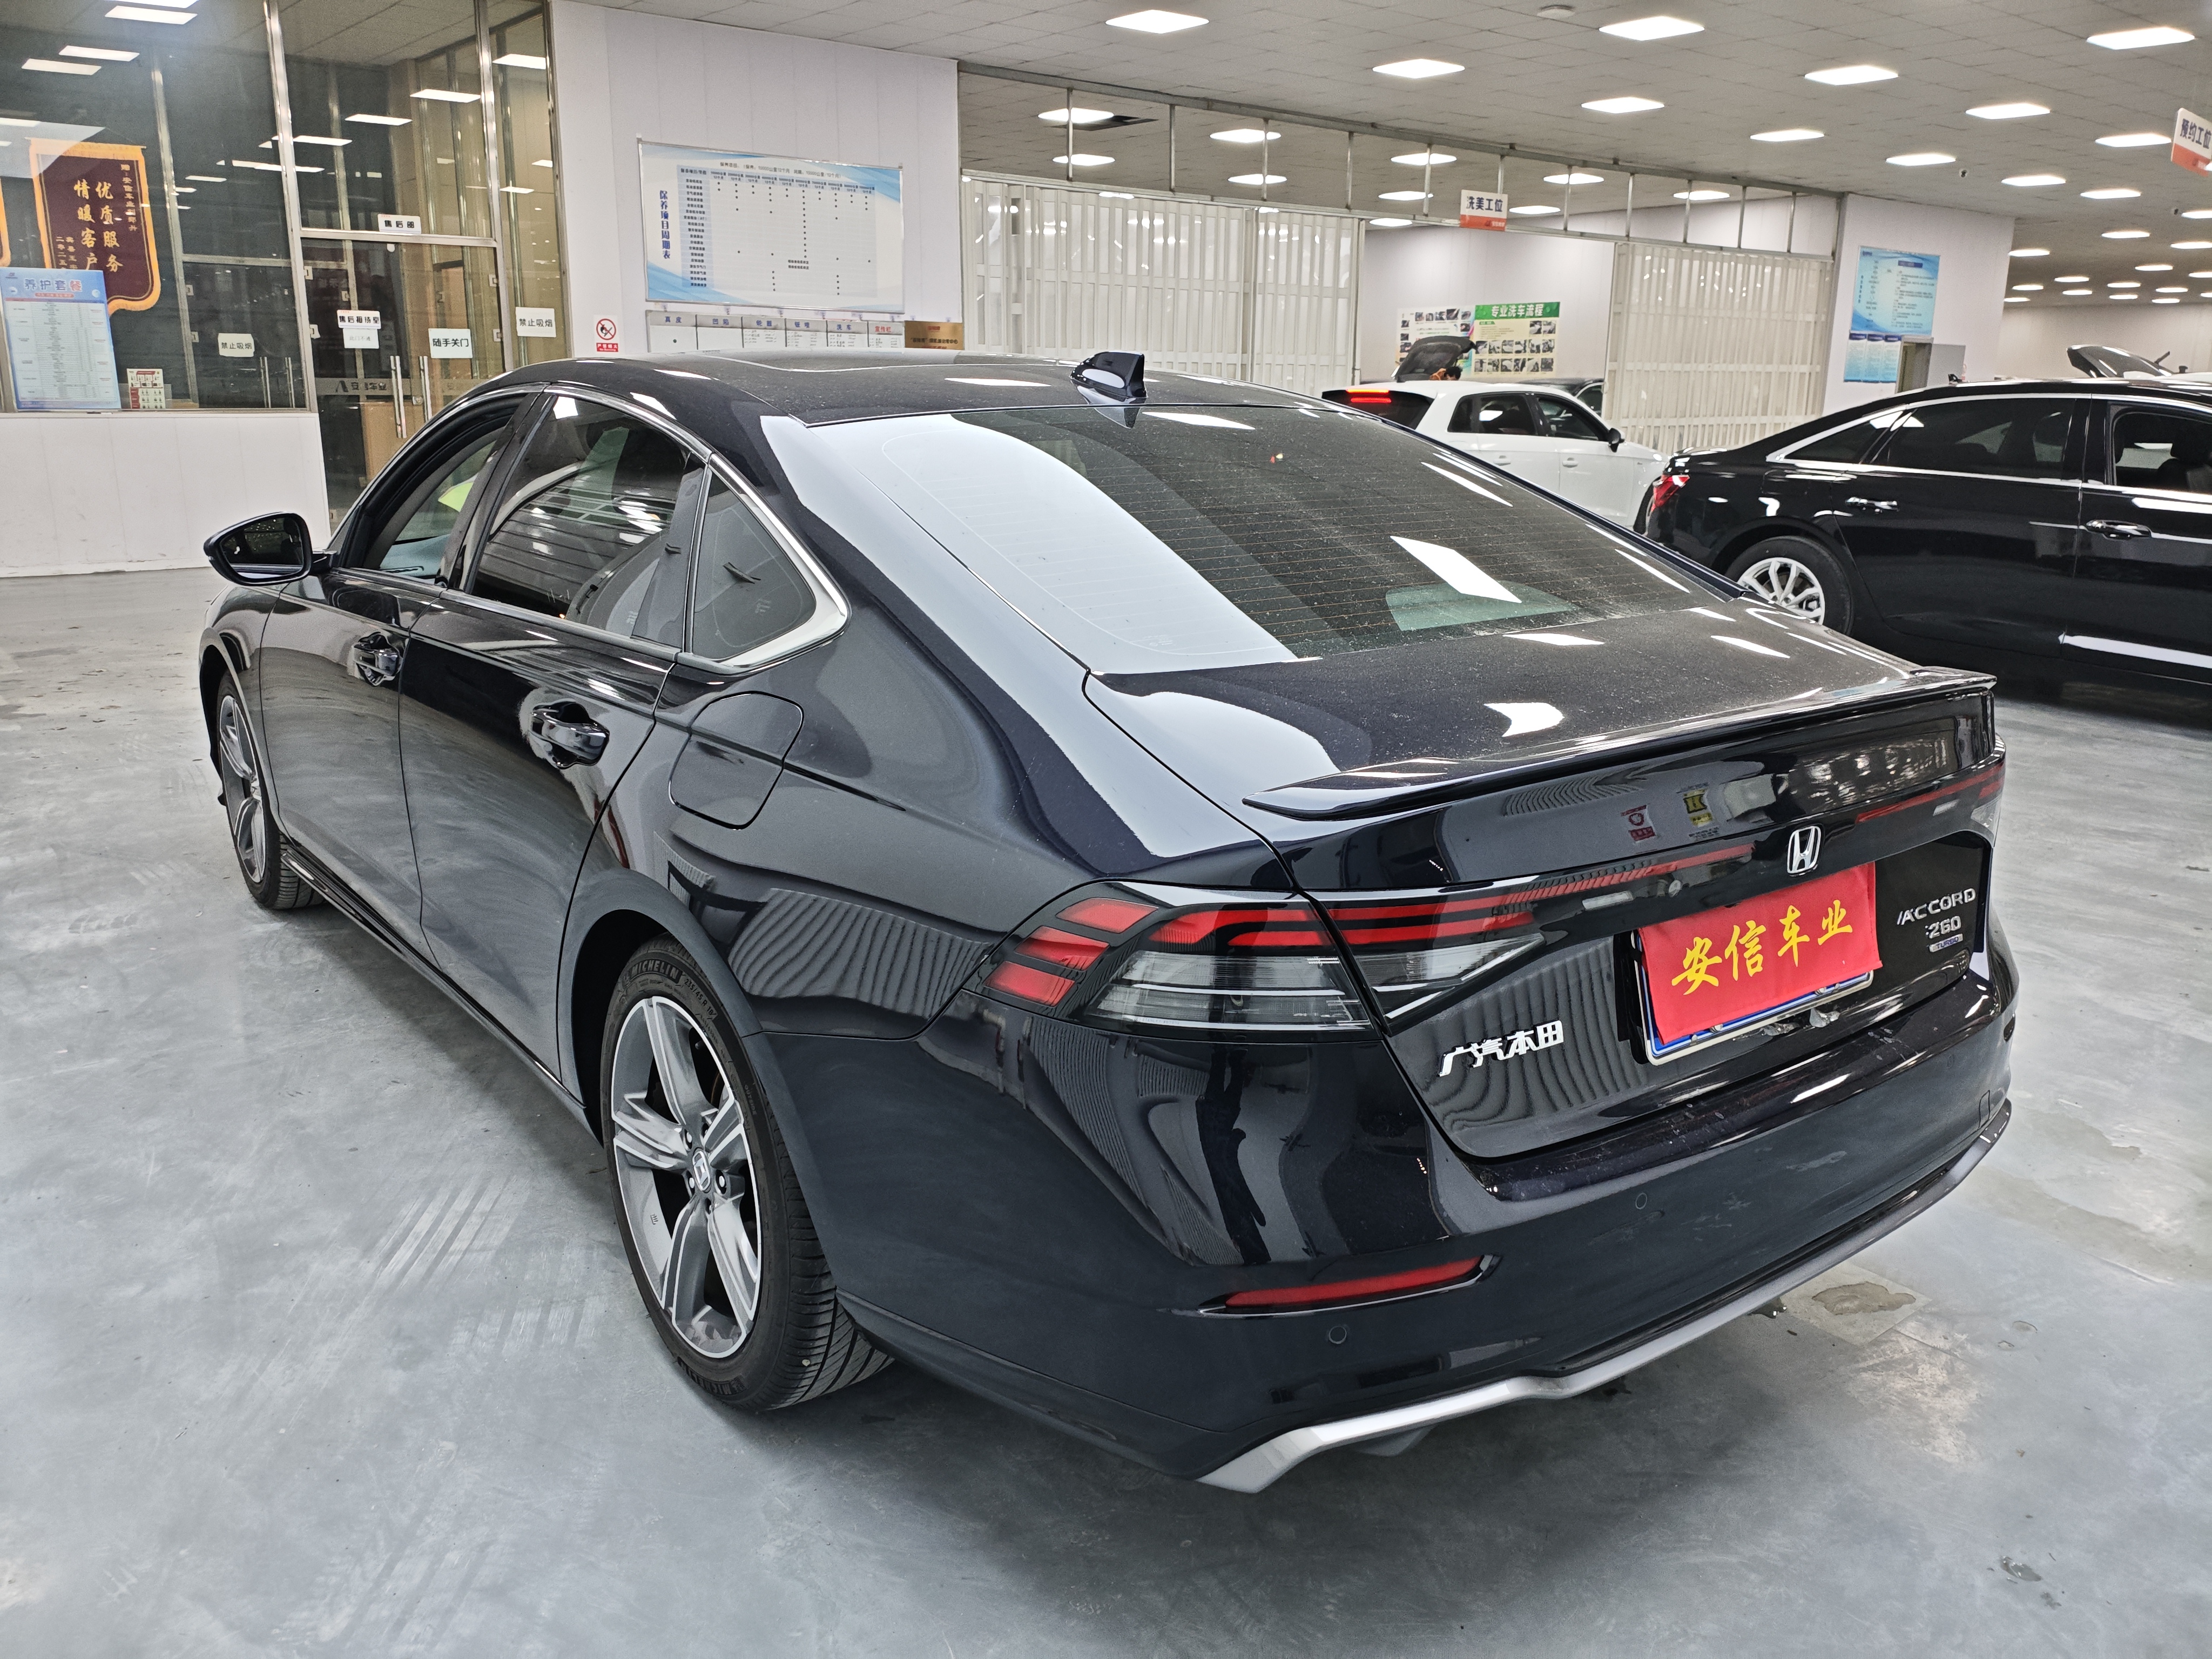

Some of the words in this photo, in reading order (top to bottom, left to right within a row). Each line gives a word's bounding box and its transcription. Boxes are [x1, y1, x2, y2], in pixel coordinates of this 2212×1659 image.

[2180, 118, 2211, 149] 预约工位
[1466, 196, 1503, 212] 洗美工位
[73, 179, 98, 270] 情暖客户
[95, 181, 124, 272] 优质服务
[659, 190, 671, 259] 保养项目周期表
[25, 279, 82, 292] 养护套餐
[1492, 304, 1544, 318] 专业洗车流程
[519, 318, 553, 328] 禁止吸烟
[221, 342, 252, 350] 禁止吸烟
[432, 338, 469, 347] 随手关门
[1896, 888, 1976, 925] ACCORD
[1927, 915, 1961, 939] 260
[1671, 899, 1853, 995] 安信车业
[1936, 936, 1959, 949] TURBO
[631, 960, 679, 980] MICHELIN
[684, 979, 704, 1000] 235/45
[1439, 1020, 1564, 1077] 广汽本田
